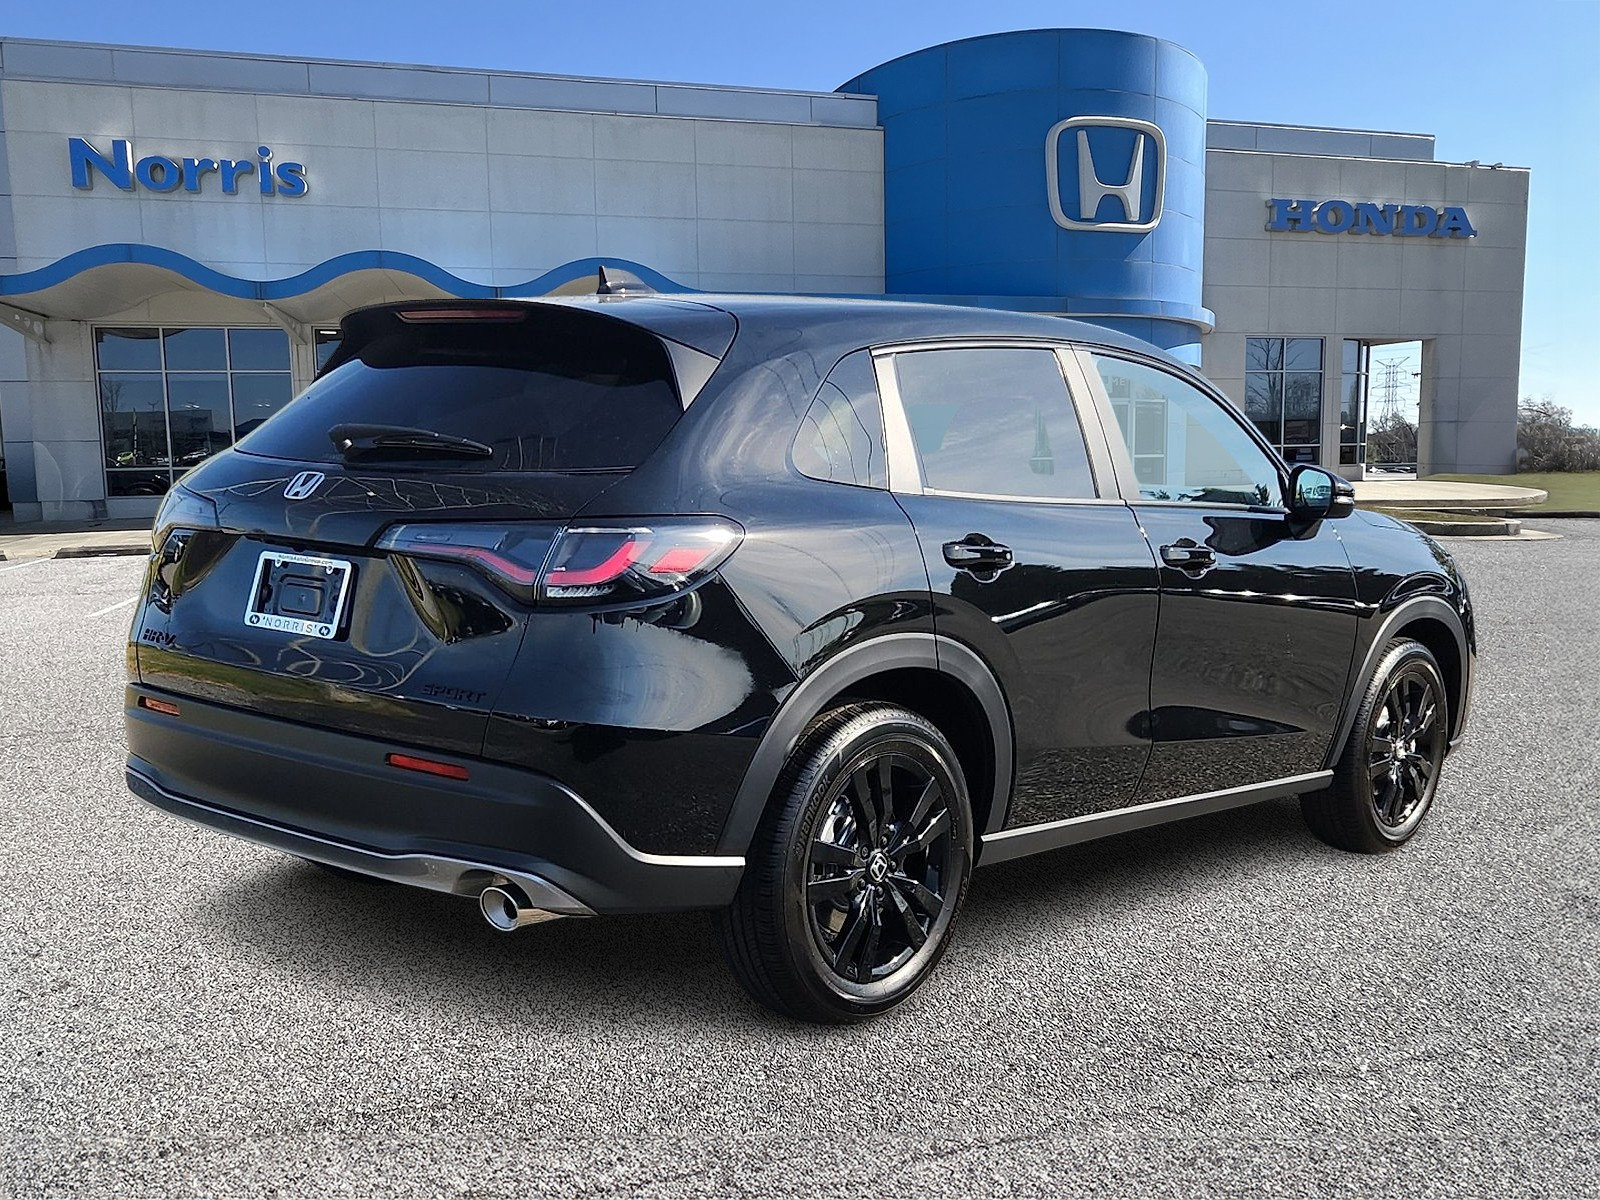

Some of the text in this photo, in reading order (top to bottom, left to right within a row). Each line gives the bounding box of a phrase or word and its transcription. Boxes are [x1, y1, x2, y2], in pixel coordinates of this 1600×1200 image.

[68, 137, 308, 197] Norris
[1265, 198, 1477, 239] HONDA
[421, 684, 487, 703] SPORT
